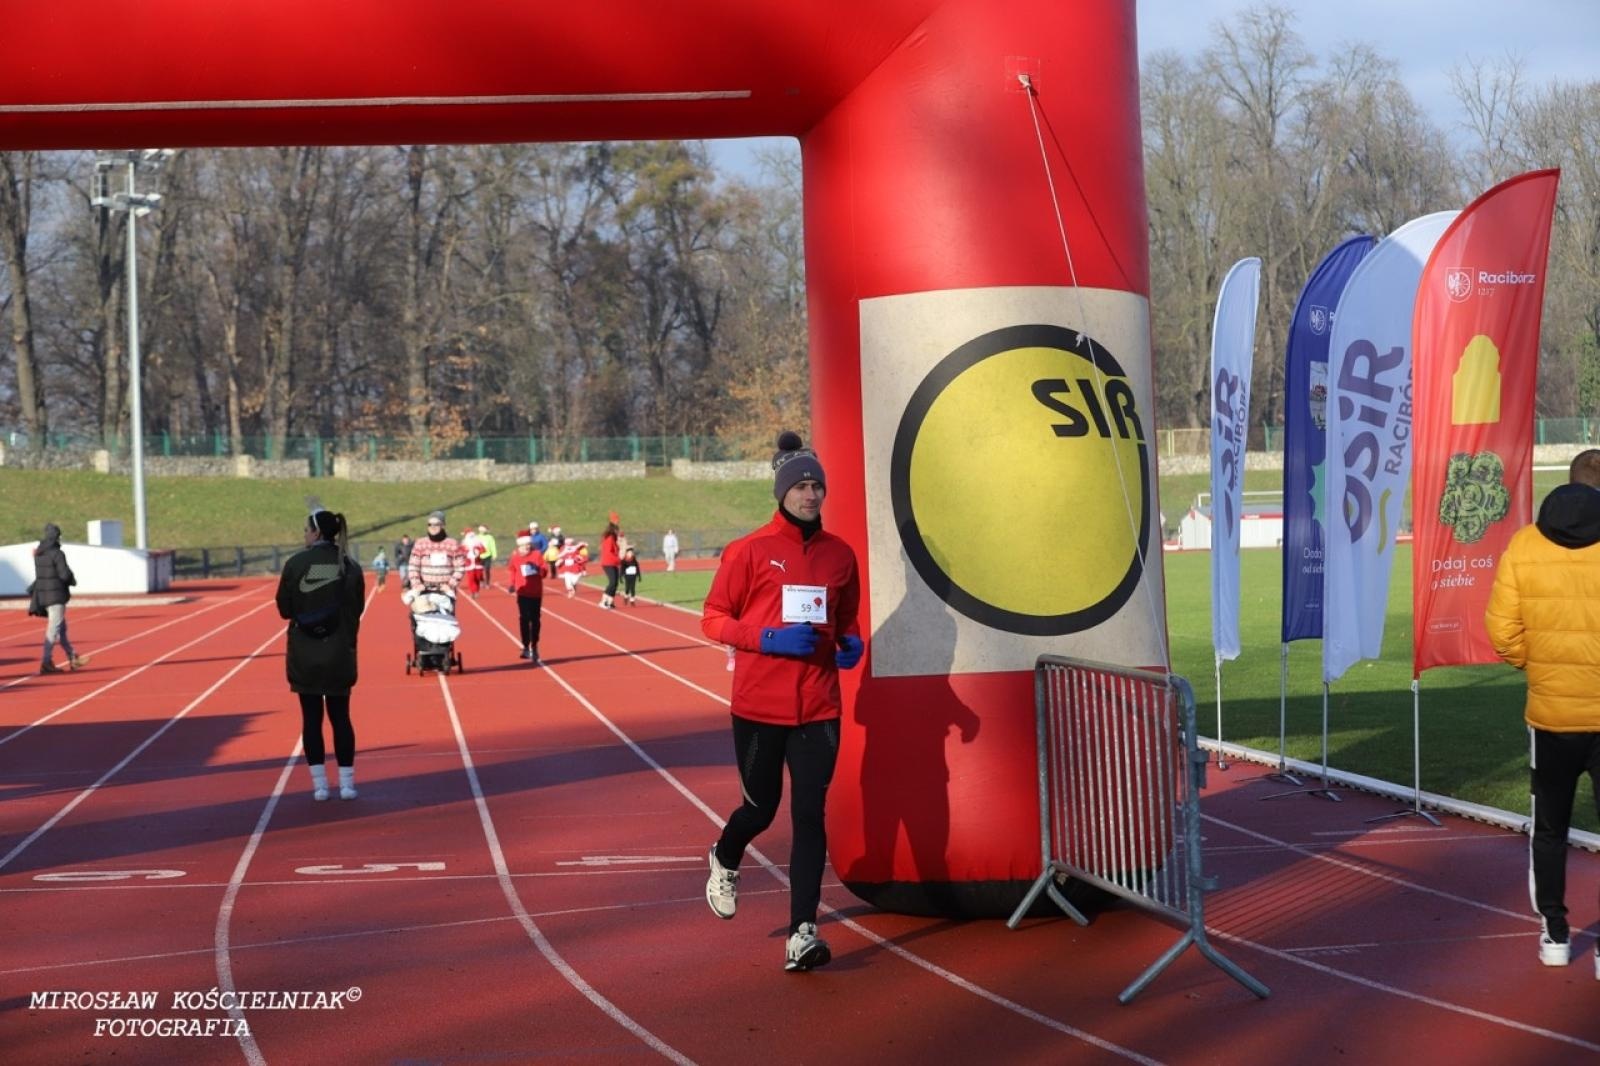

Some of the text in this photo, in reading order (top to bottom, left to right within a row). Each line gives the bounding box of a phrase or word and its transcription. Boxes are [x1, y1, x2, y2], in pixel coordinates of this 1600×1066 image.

[1031, 378, 1146, 440] SIR
[1470, 554, 1494, 569] coś
[1440, 573, 1475, 588] siebie
[801, 603, 812, 613] 59
[294, 861, 447, 875] 5
